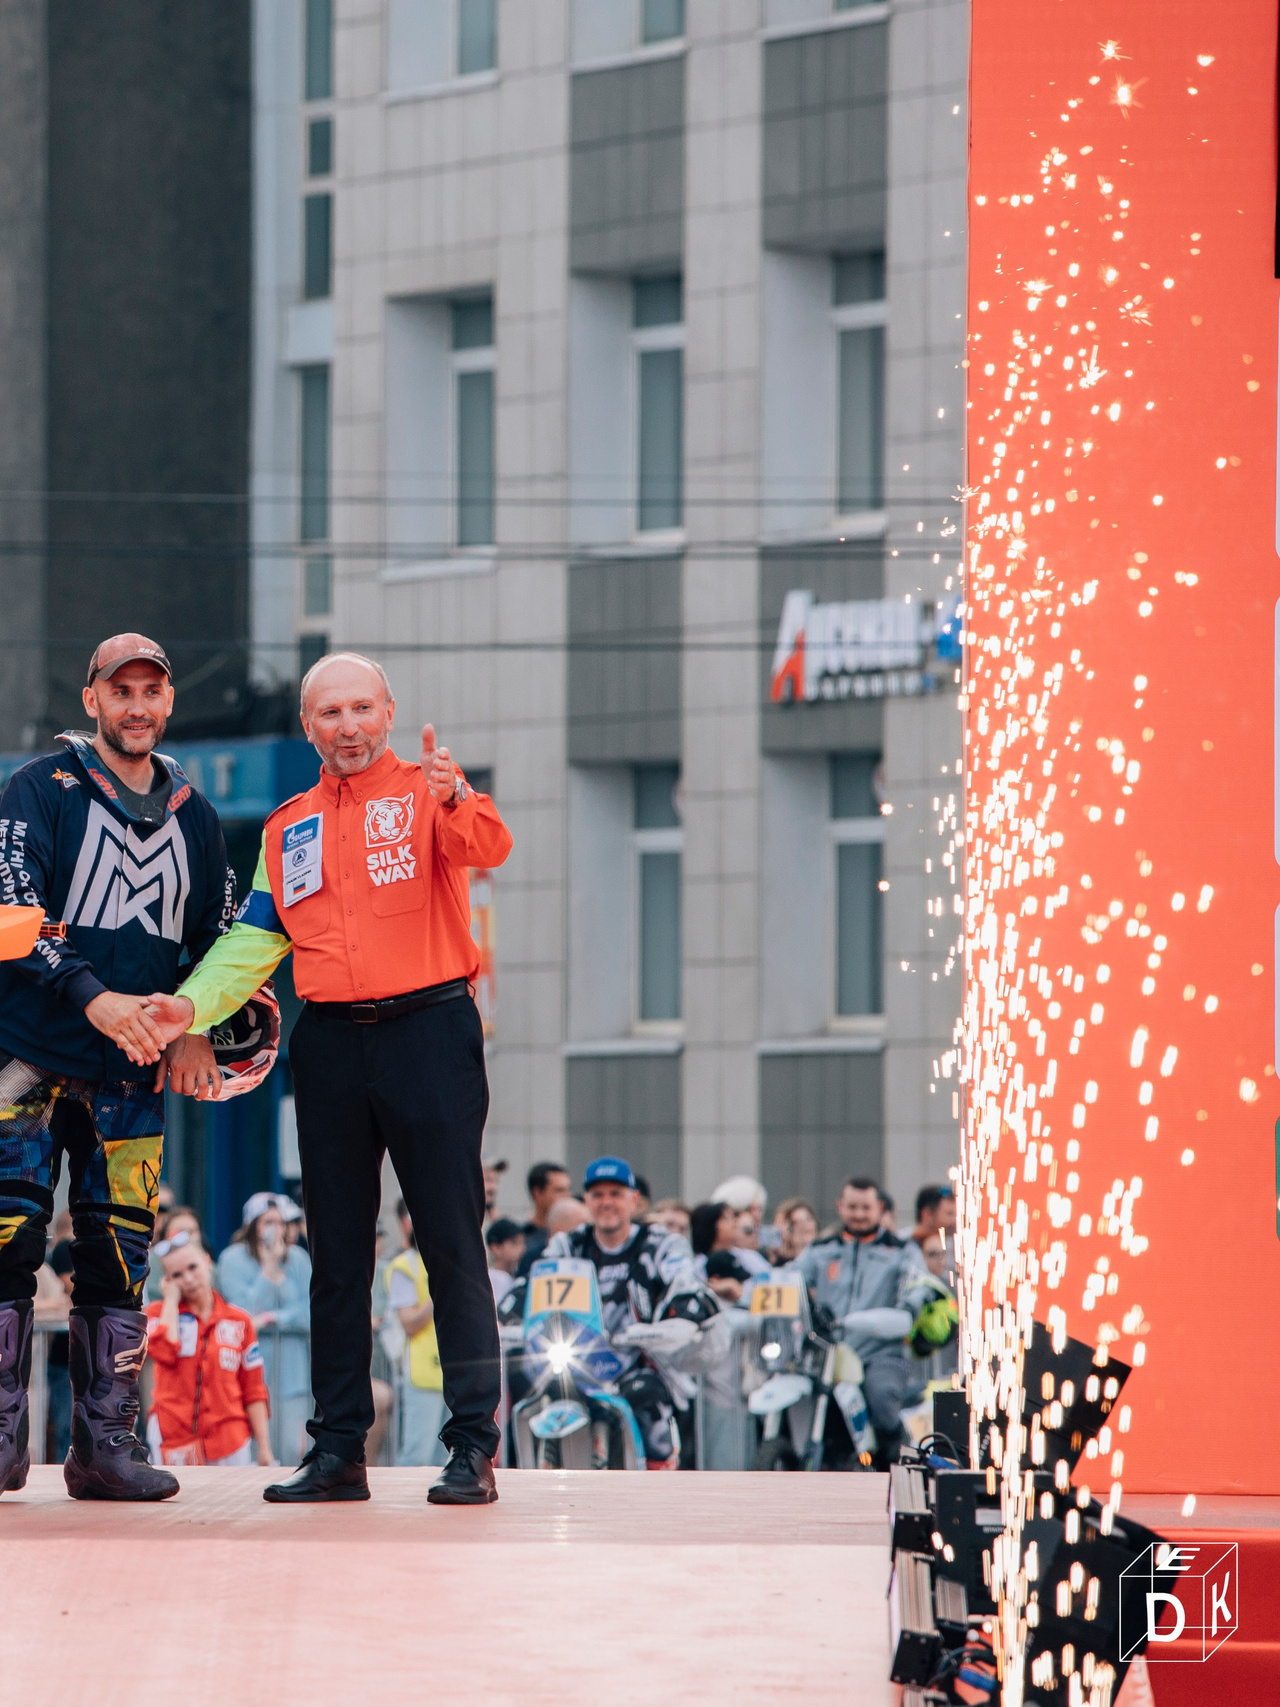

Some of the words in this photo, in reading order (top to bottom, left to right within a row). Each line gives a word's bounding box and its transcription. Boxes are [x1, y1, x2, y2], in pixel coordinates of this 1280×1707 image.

[366, 843, 416, 872] SILK
[368, 860, 417, 887] WAY
[546, 1278, 574, 1306] 17
[760, 1286, 783, 1311] 21
